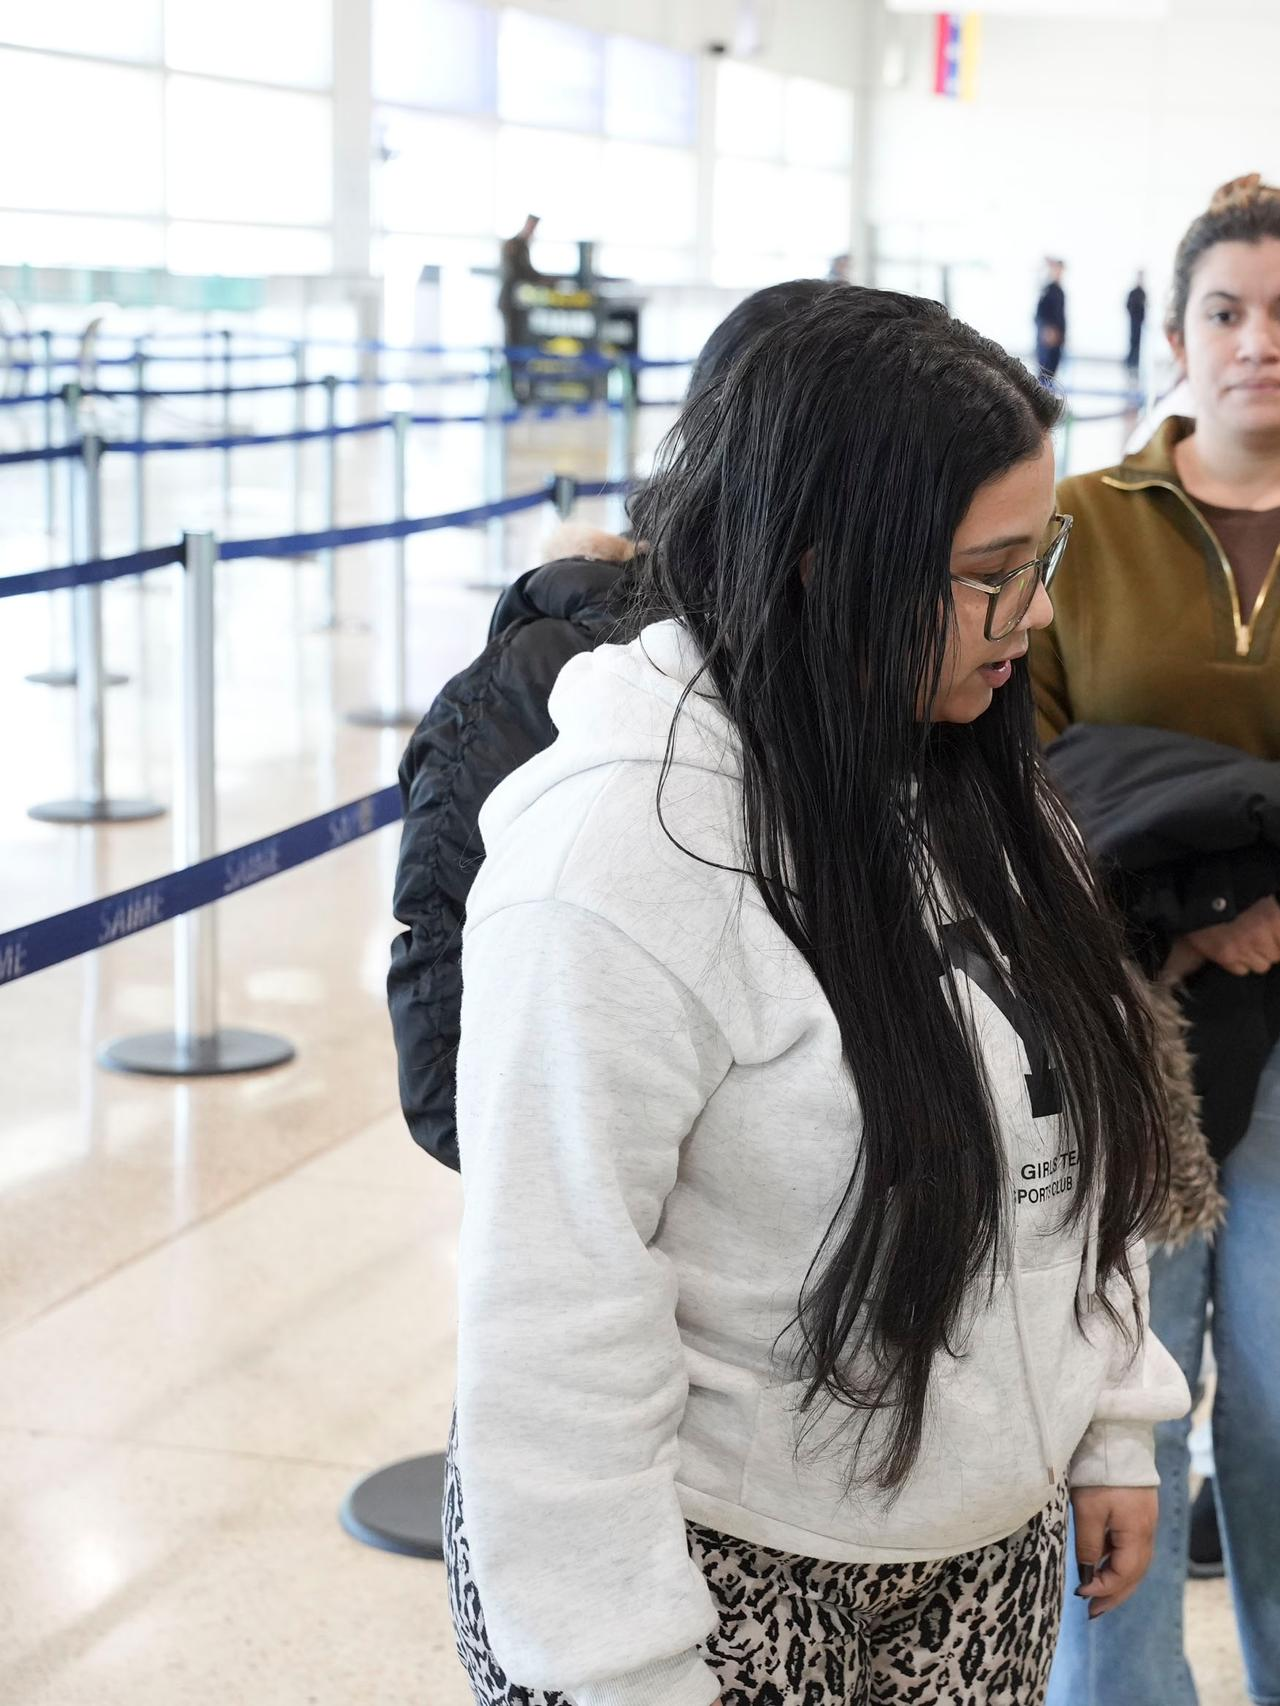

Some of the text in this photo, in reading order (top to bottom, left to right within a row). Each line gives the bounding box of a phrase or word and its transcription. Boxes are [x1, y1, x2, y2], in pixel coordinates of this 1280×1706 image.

[1020, 1150, 1080, 1180] GIRLS TE
[1051, 1176, 1073, 1196] CLUB
